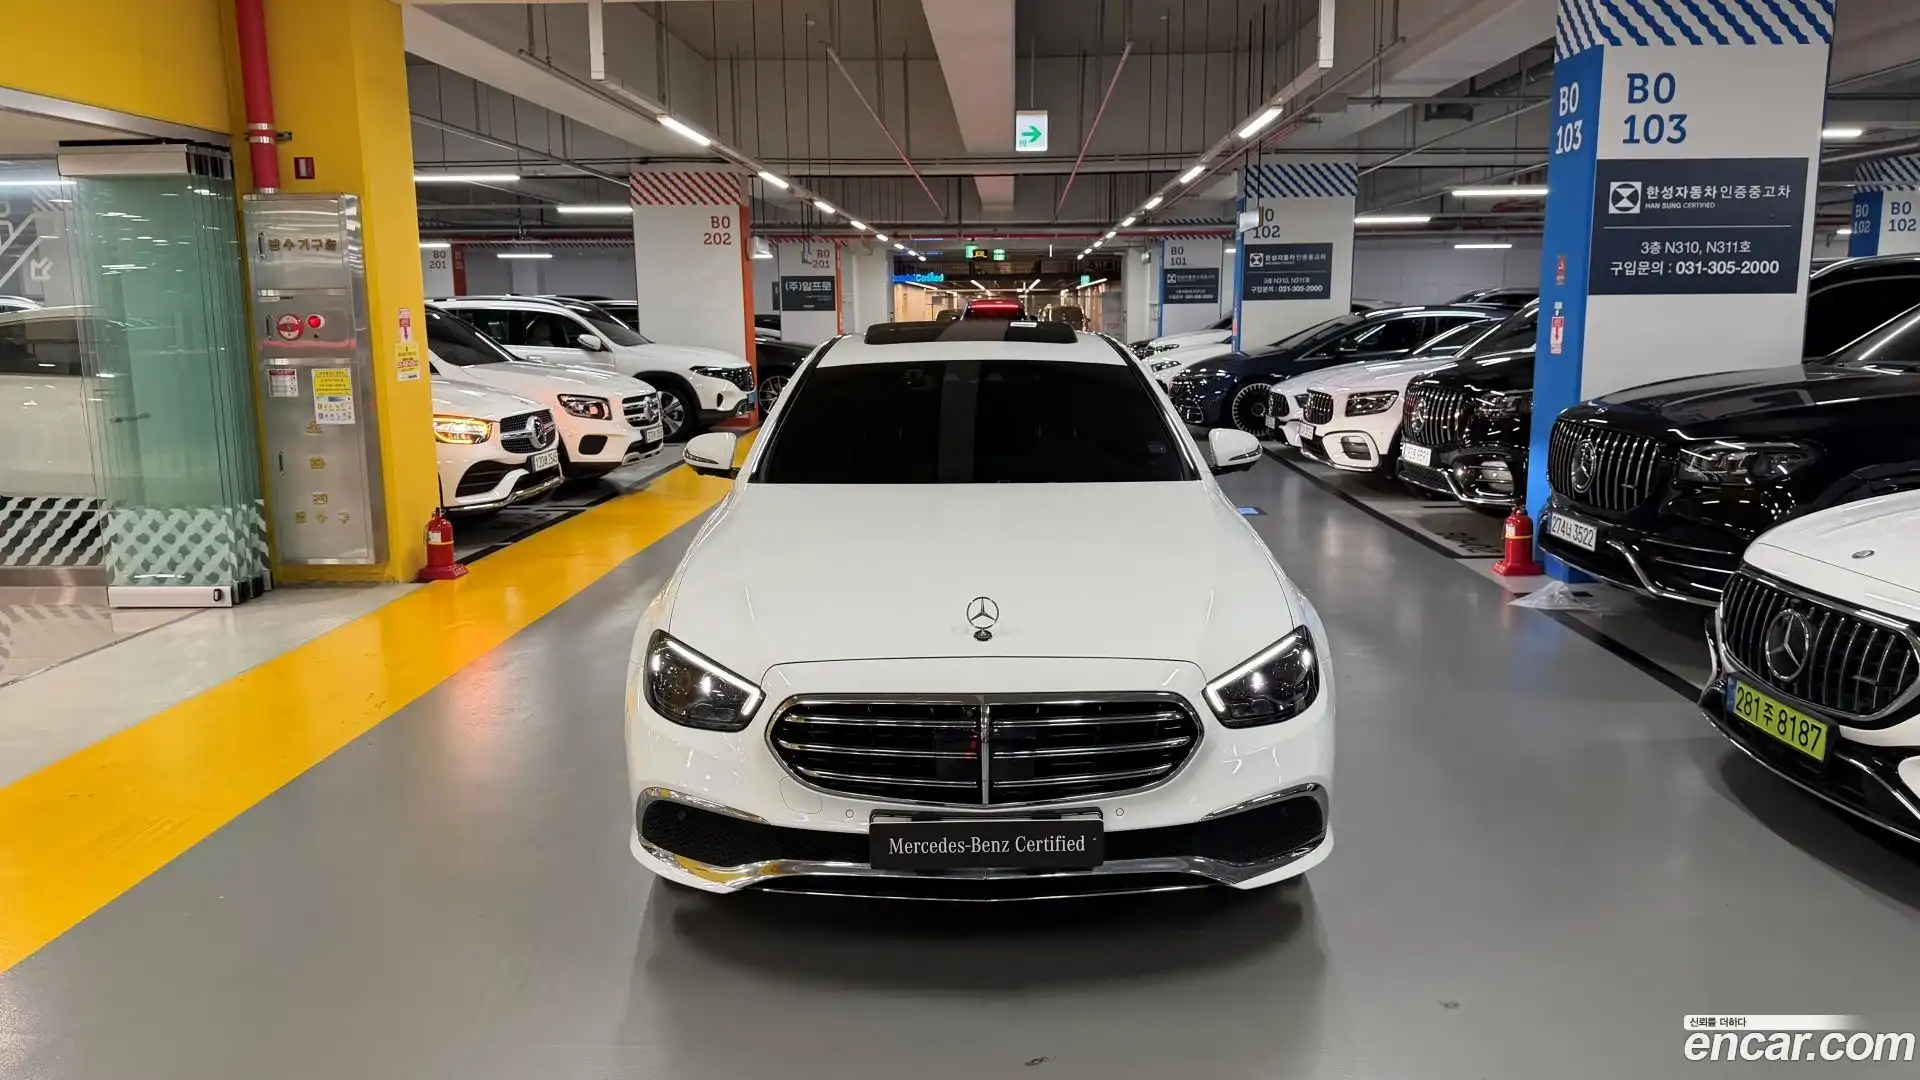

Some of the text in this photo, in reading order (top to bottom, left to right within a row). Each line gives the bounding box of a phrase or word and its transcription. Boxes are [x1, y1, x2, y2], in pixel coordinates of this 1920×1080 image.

[1622, 114, 1687, 144] 103
[1555, 119, 1583, 154] 103
[1253, 225, 1281, 238] 102
[1853, 220, 1871, 234] 102
[1888, 218, 1917, 232] 102
[703, 232, 732, 245] 202
[1641, 240, 1752, 255] 3층 N310, N311호
[429, 261, 447, 269] 201
[812, 260, 830, 269] 201
[1171, 257, 1187, 266] 101
[1610, 261, 1664, 276] 구입문의
[1675, 260, 1780, 275] 031-305-2000
[888, 835, 1086, 855] Mercedes-Benz Certified
